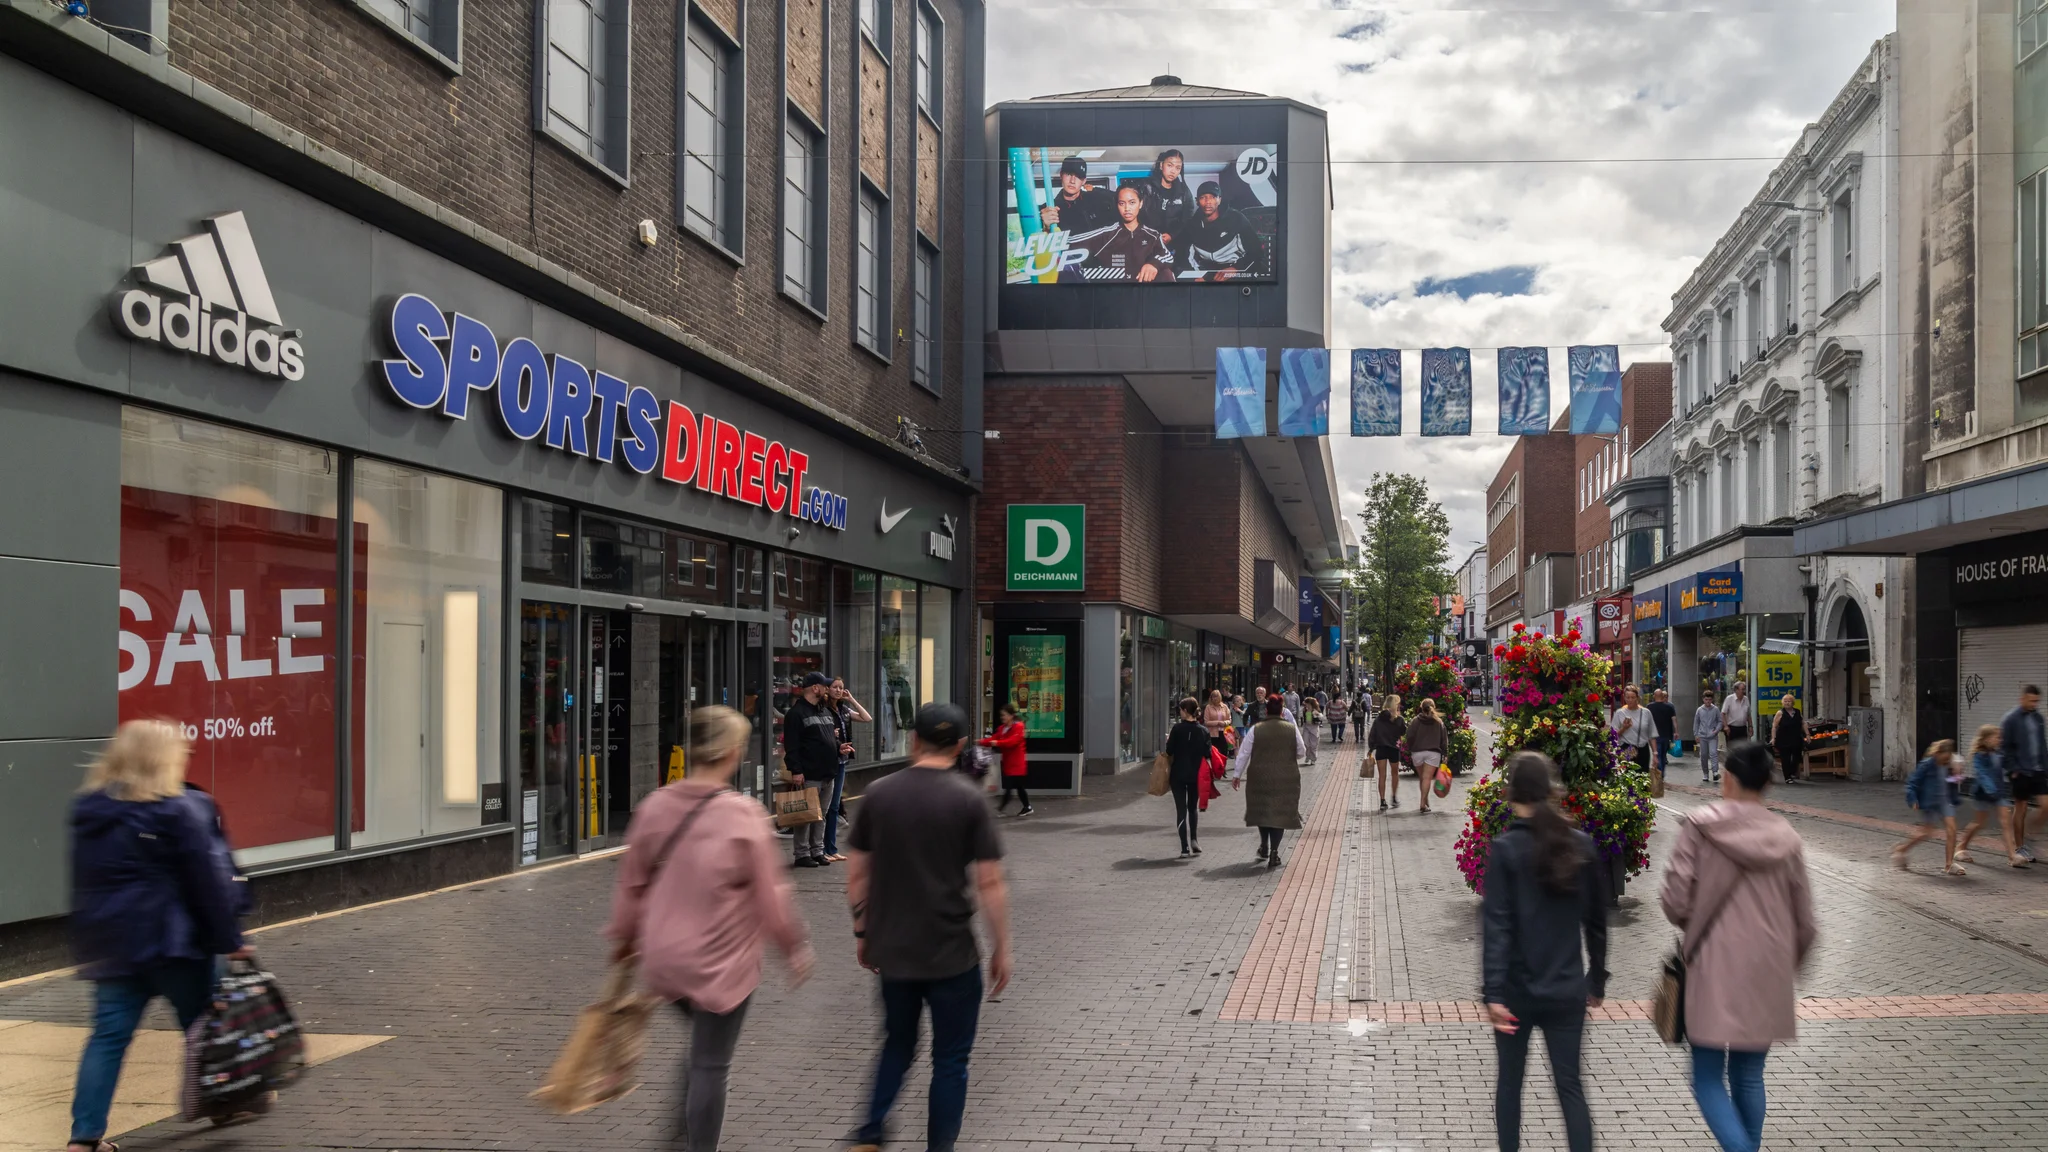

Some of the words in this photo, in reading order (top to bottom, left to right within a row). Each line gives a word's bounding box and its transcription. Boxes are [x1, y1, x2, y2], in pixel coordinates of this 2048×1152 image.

[1241, 157, 1268, 175] JD
[1014, 230, 1071, 257] LEVEL
[1024, 248, 1090, 276] UP
[121, 289, 305, 382] adidas
[930, 531, 953, 561] PUMA
[1025, 519, 1072, 566] D
[1014, 572, 1078, 581] DEICHMANN
[1709, 578, 1732, 586] Card
[1956, 561, 1997, 584] HOUSE
[2000, 558, 2018, 578] OF
[2021, 554, 2048, 575] FRA
[1702, 587, 1738, 596] Factory
[791, 617, 827, 648] SALE
[1765, 667, 1793, 684] 15p
[1769, 689, 1780, 697] 10
[179, 720, 199, 740] to
[203, 717, 245, 740] 50%
[249, 715, 276, 737] off.
